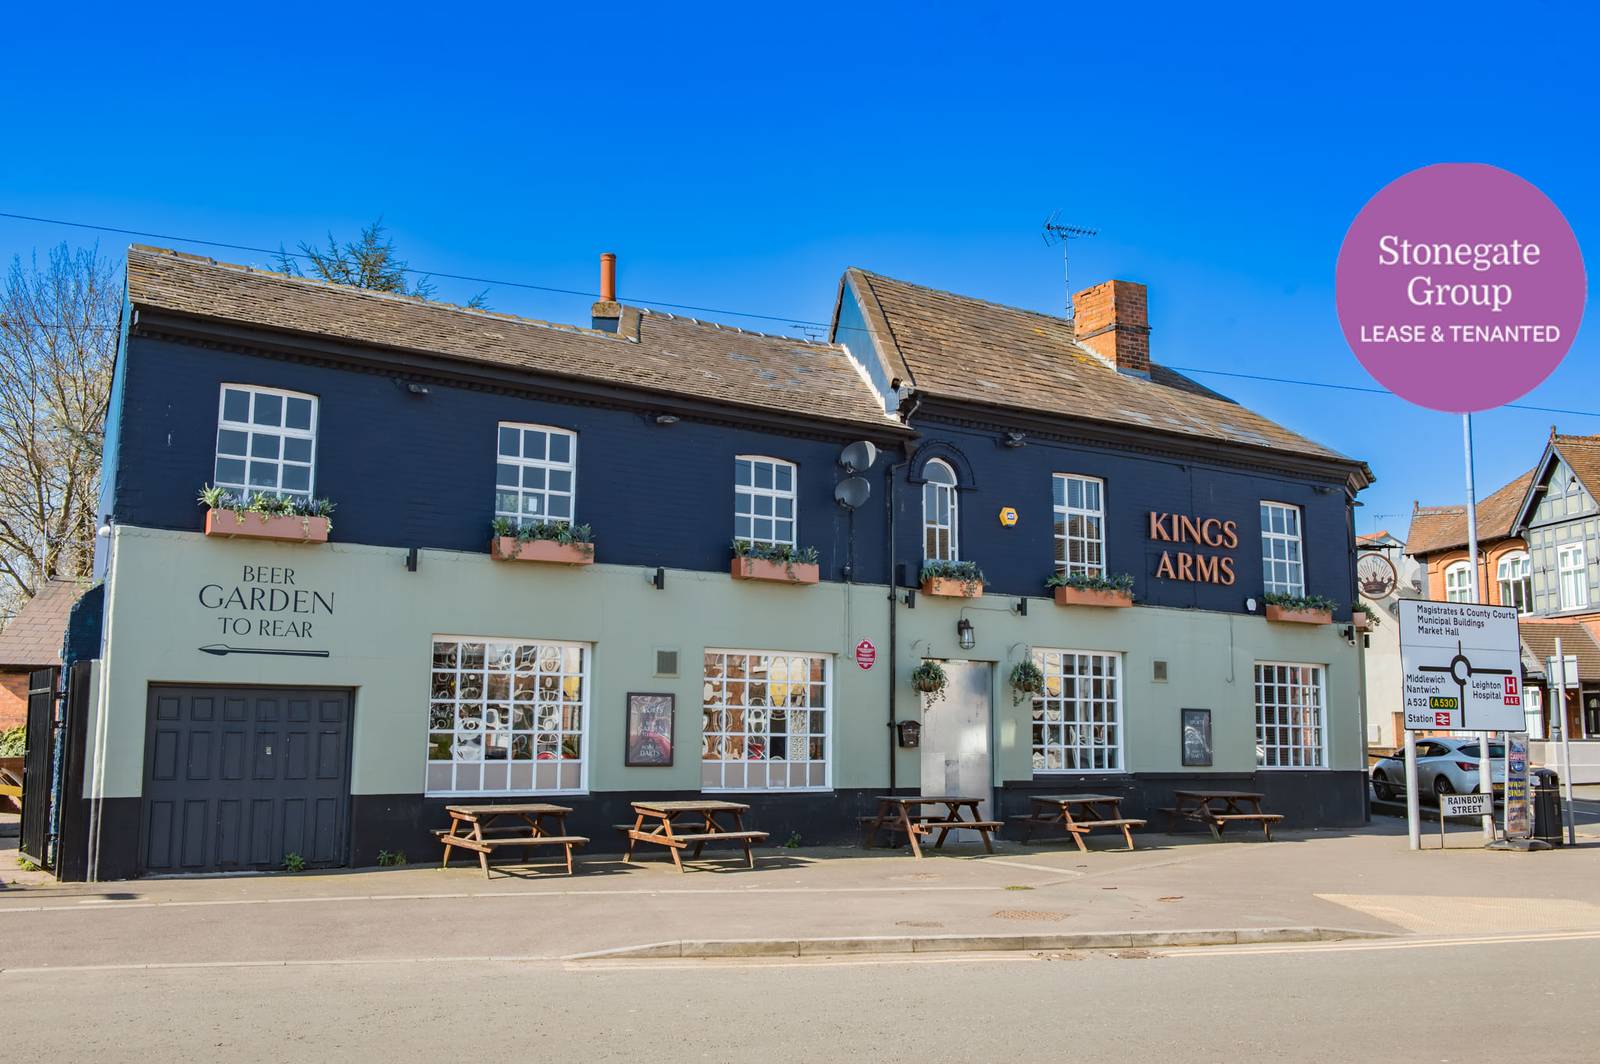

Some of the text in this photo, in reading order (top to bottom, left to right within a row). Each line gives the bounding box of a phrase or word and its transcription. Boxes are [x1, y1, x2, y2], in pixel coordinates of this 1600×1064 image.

[1150, 511, 1238, 549] KINGS
[1155, 550, 1235, 586] ARMS
[243, 565, 295, 585] BEER
[199, 584, 334, 615] GARDEN
[1416, 605, 1516, 619] Magistrates & County Courts
[1418, 615, 1484, 628] Municipal Buildings
[218, 617, 312, 638] TO REAR
[1418, 626, 1460, 636] Market Hall
[1406, 674, 1446, 684] Middlewich
[1406, 685, 1440, 694] Nantwich
[1472, 680, 1502, 692] Leighton
[1506, 678, 1516, 693] H
[1473, 691, 1502, 701] Hospital
[1505, 697, 1519, 705] A&E
[1407, 698, 1458, 709] A532 (A530)
[1408, 714, 1434, 723] Station
[1448, 796, 1484, 804] RAINBOW
[1452, 805, 1482, 814] STREET
